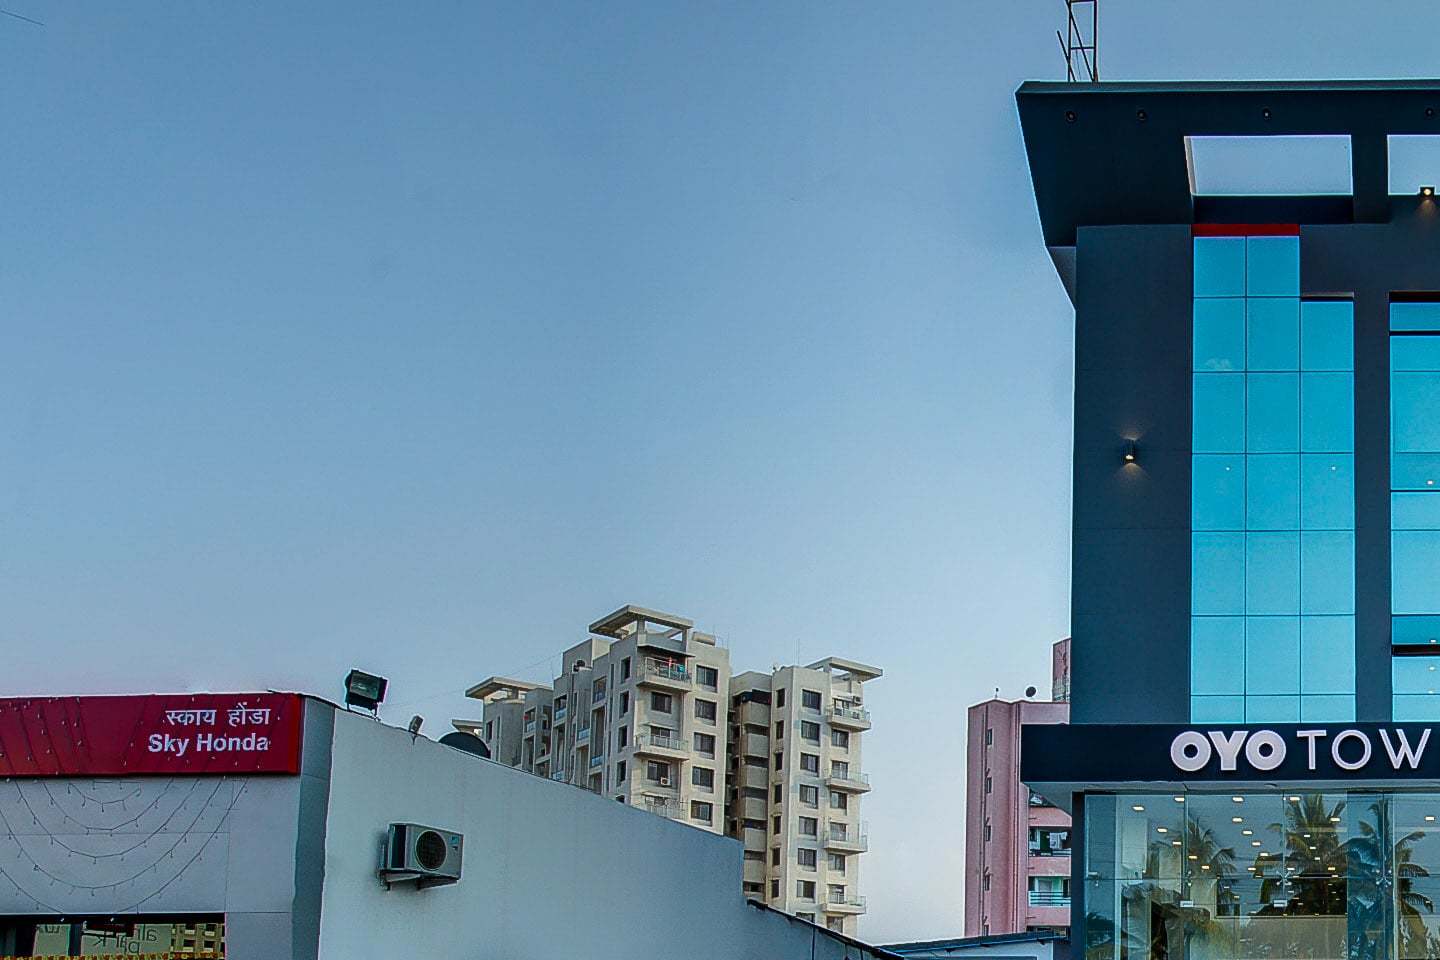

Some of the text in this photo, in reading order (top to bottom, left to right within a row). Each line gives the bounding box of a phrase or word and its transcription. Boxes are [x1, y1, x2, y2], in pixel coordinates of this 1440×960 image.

[165, 709, 217, 726] स्काय
[148, 732, 269, 756] Sky Honda
[1170, 729, 1286, 772] OYO
